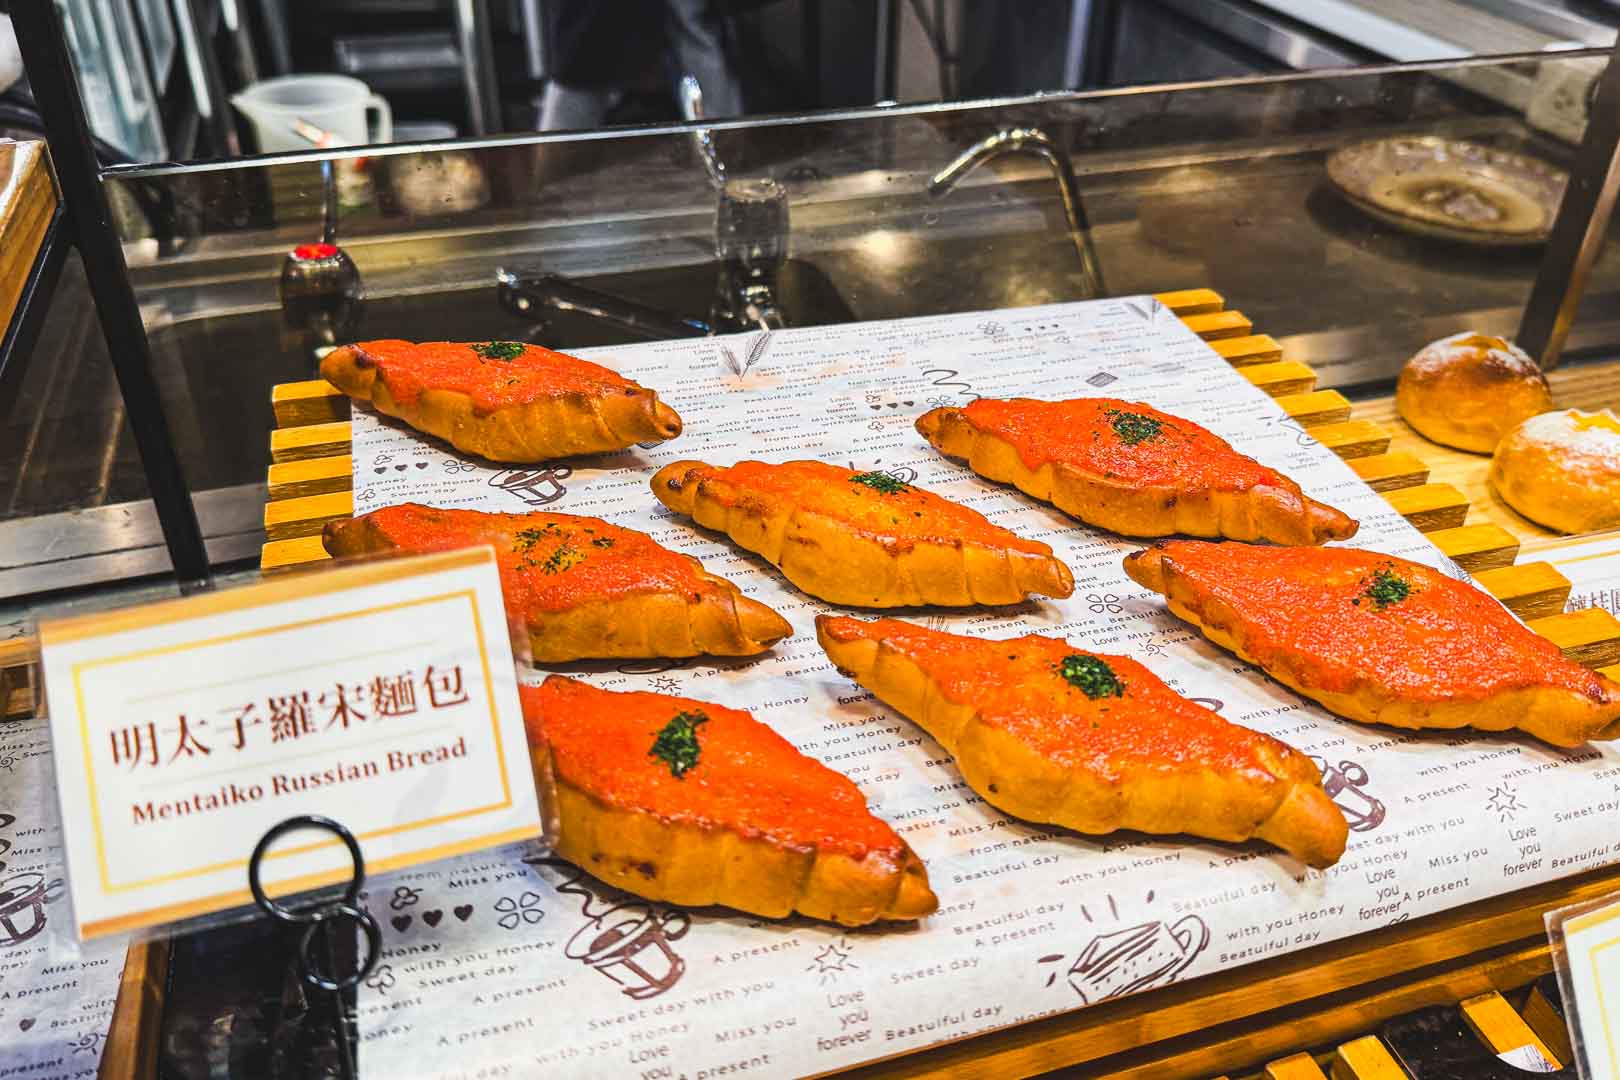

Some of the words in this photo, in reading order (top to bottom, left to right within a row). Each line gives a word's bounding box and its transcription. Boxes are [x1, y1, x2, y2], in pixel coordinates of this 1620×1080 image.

[1083, 548, 1123, 561] present
[1091, 559, 1114, 569] you
[724, 569, 755, 577] from
[1098, 578, 1122, 589] you
[977, 618, 1029, 634] present
[1053, 618, 1096, 631] nature
[1079, 623, 1130, 638] present
[1127, 630, 1155, 641] Miss
[1159, 625, 1185, 637] you
[781, 635, 815, 647] from
[1092, 635, 1121, 647] Love
[774, 653, 807, 664] Miss
[763, 695, 810, 711] Honey
[1240, 709, 1272, 722] with
[1273, 703, 1300, 715] you
[109, 663, 470, 773] 明太子羅宋麵包
[822, 720, 855, 732] Miss
[858, 714, 887, 727] you
[823, 736, 851, 747] you
[855, 725, 903, 740] Honey
[1293, 721, 1319, 736] you
[823, 743, 893, 763] Beatuiful
[897, 736, 924, 748] day
[1320, 737, 1346, 751] day
[843, 764, 872, 777] you
[1415, 763, 1448, 778] with
[1453, 758, 1477, 770] you
[1479, 747, 1522, 762] Honey
[1500, 768, 1532, 780] with
[1534, 761, 1559, 774] you
[131, 782, 265, 826] Mentaiko
[271, 759, 380, 799] Russian
[386, 736, 469, 773] Bread
[874, 772, 901, 784] day
[1417, 782, 1473, 802] present
[894, 808, 929, 820] with
[933, 801, 961, 814] you
[1553, 806, 1593, 824] Sweet
[1597, 799, 1619, 814] day
[948, 824, 984, 837] Miss
[1374, 833, 1400, 846] day
[1404, 823, 1437, 838] with
[1439, 815, 1467, 832] you
[1507, 826, 1538, 843] Love
[969, 841, 1009, 857] from
[1428, 854, 1460, 870] Miss
[1462, 846, 1490, 864] you
[1518, 842, 1542, 861] you
[1551, 844, 1610, 870] Beatuiful
[1032, 853, 1061, 867] day
[1330, 861, 1360, 878] you
[1363, 850, 1409, 866] Honey
[1502, 857, 1544, 878] forever
[448, 875, 489, 890] Miss
[494, 869, 529, 885] you
[1056, 871, 1094, 887] with
[1097, 862, 1128, 879] you
[1366, 867, 1397, 885] Love
[1249, 880, 1278, 895] day
[1375, 884, 1401, 903] you
[1416, 877, 1472, 901] present
[1038, 902, 1066, 916] day
[1360, 900, 1403, 922] forever
[1225, 926, 1261, 942] with
[1265, 917, 1294, 934] you
[1297, 903, 1346, 924] Honey
[991, 921, 1057, 947] present
[731, 938, 802, 963] present
[1218, 936, 1290, 964] Beatuiful
[1294, 929, 1323, 944] day
[41, 963, 75, 976] Miss
[81, 958, 109, 969] you
[403, 959, 448, 974] with
[455, 952, 489, 966] you
[889, 963, 945, 985] Sweet
[950, 957, 981, 972] day
[417, 970, 475, 988] Sweet
[484, 964, 520, 979] day
[16, 978, 80, 1000] present
[492, 977, 568, 1004] present
[827, 989, 866, 1009] Love
[361, 997, 423, 1016] resent
[588, 1010, 648, 1032] Sweet
[654, 1000, 689, 1017] day
[693, 989, 737, 1006] with
[740, 980, 777, 996] you
[714, 1029, 756, 1044] Miss
[763, 1015, 799, 1034] you
[838, 1008, 870, 1031] you
[884, 1011, 968, 1042] Beatuiful
[971, 1003, 1004, 1020] day
[359, 1022, 416, 1045] oney
[458, 1016, 536, 1046] present
[816, 1027, 873, 1053] forever
[628, 1043, 672, 1065] Love
[696, 1052, 772, 1080] present
